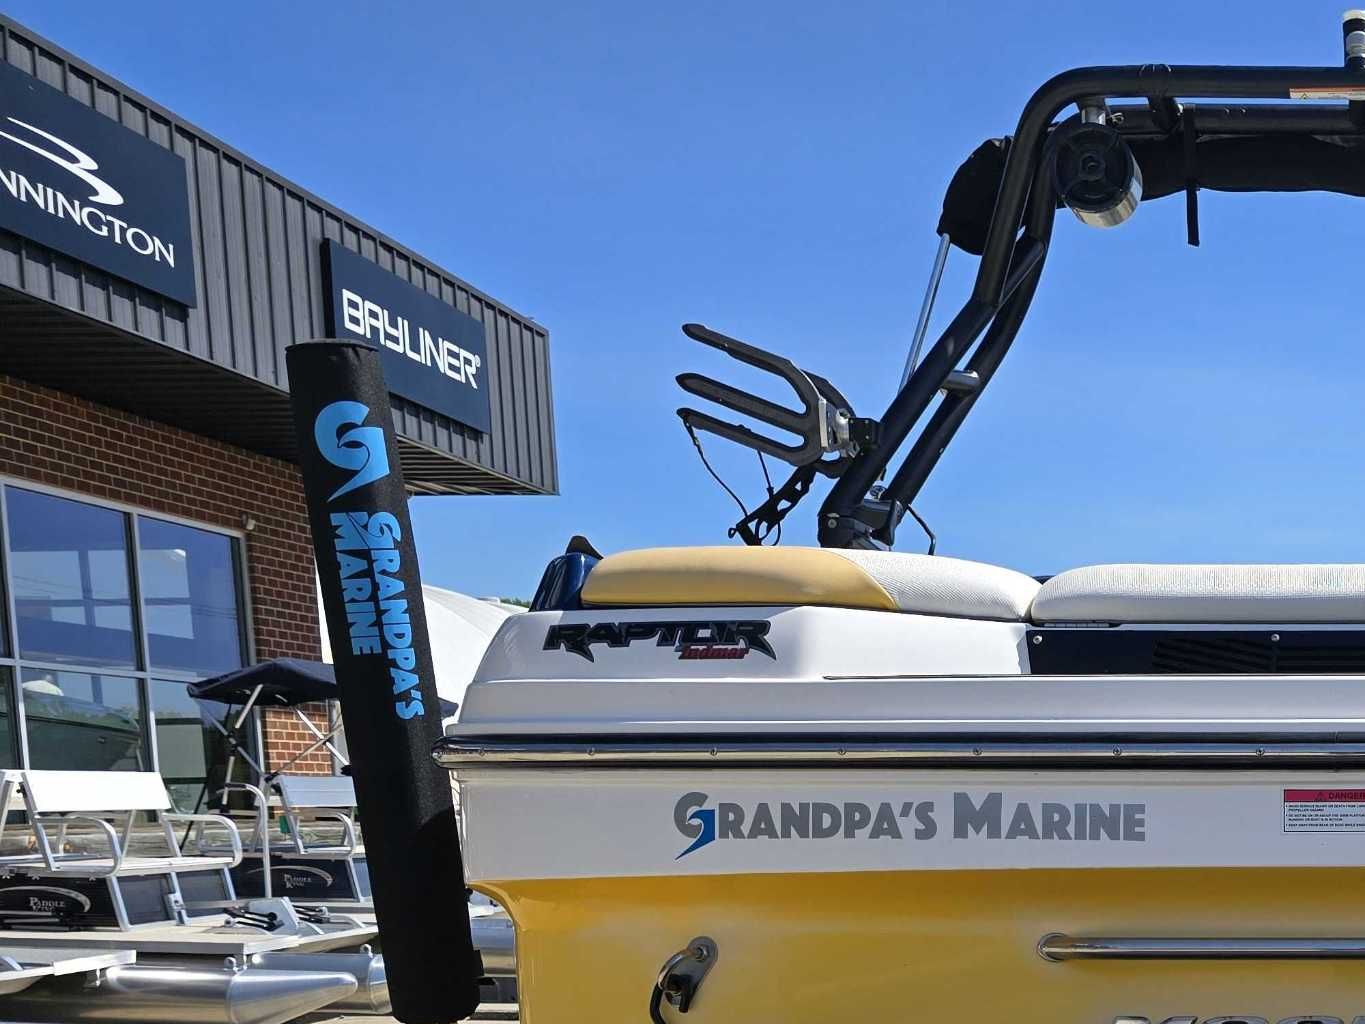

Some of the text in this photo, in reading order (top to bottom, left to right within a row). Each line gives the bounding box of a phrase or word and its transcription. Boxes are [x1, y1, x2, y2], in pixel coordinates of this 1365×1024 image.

[330, 511, 383, 656] MARINE
[352, 511, 425, 720] GRANDPA'S
[542, 619, 777, 663] RAPTOR
[673, 791, 1146, 860] GRANDPA'S MARINE
[1328, 791, 1365, 800] DANGER
